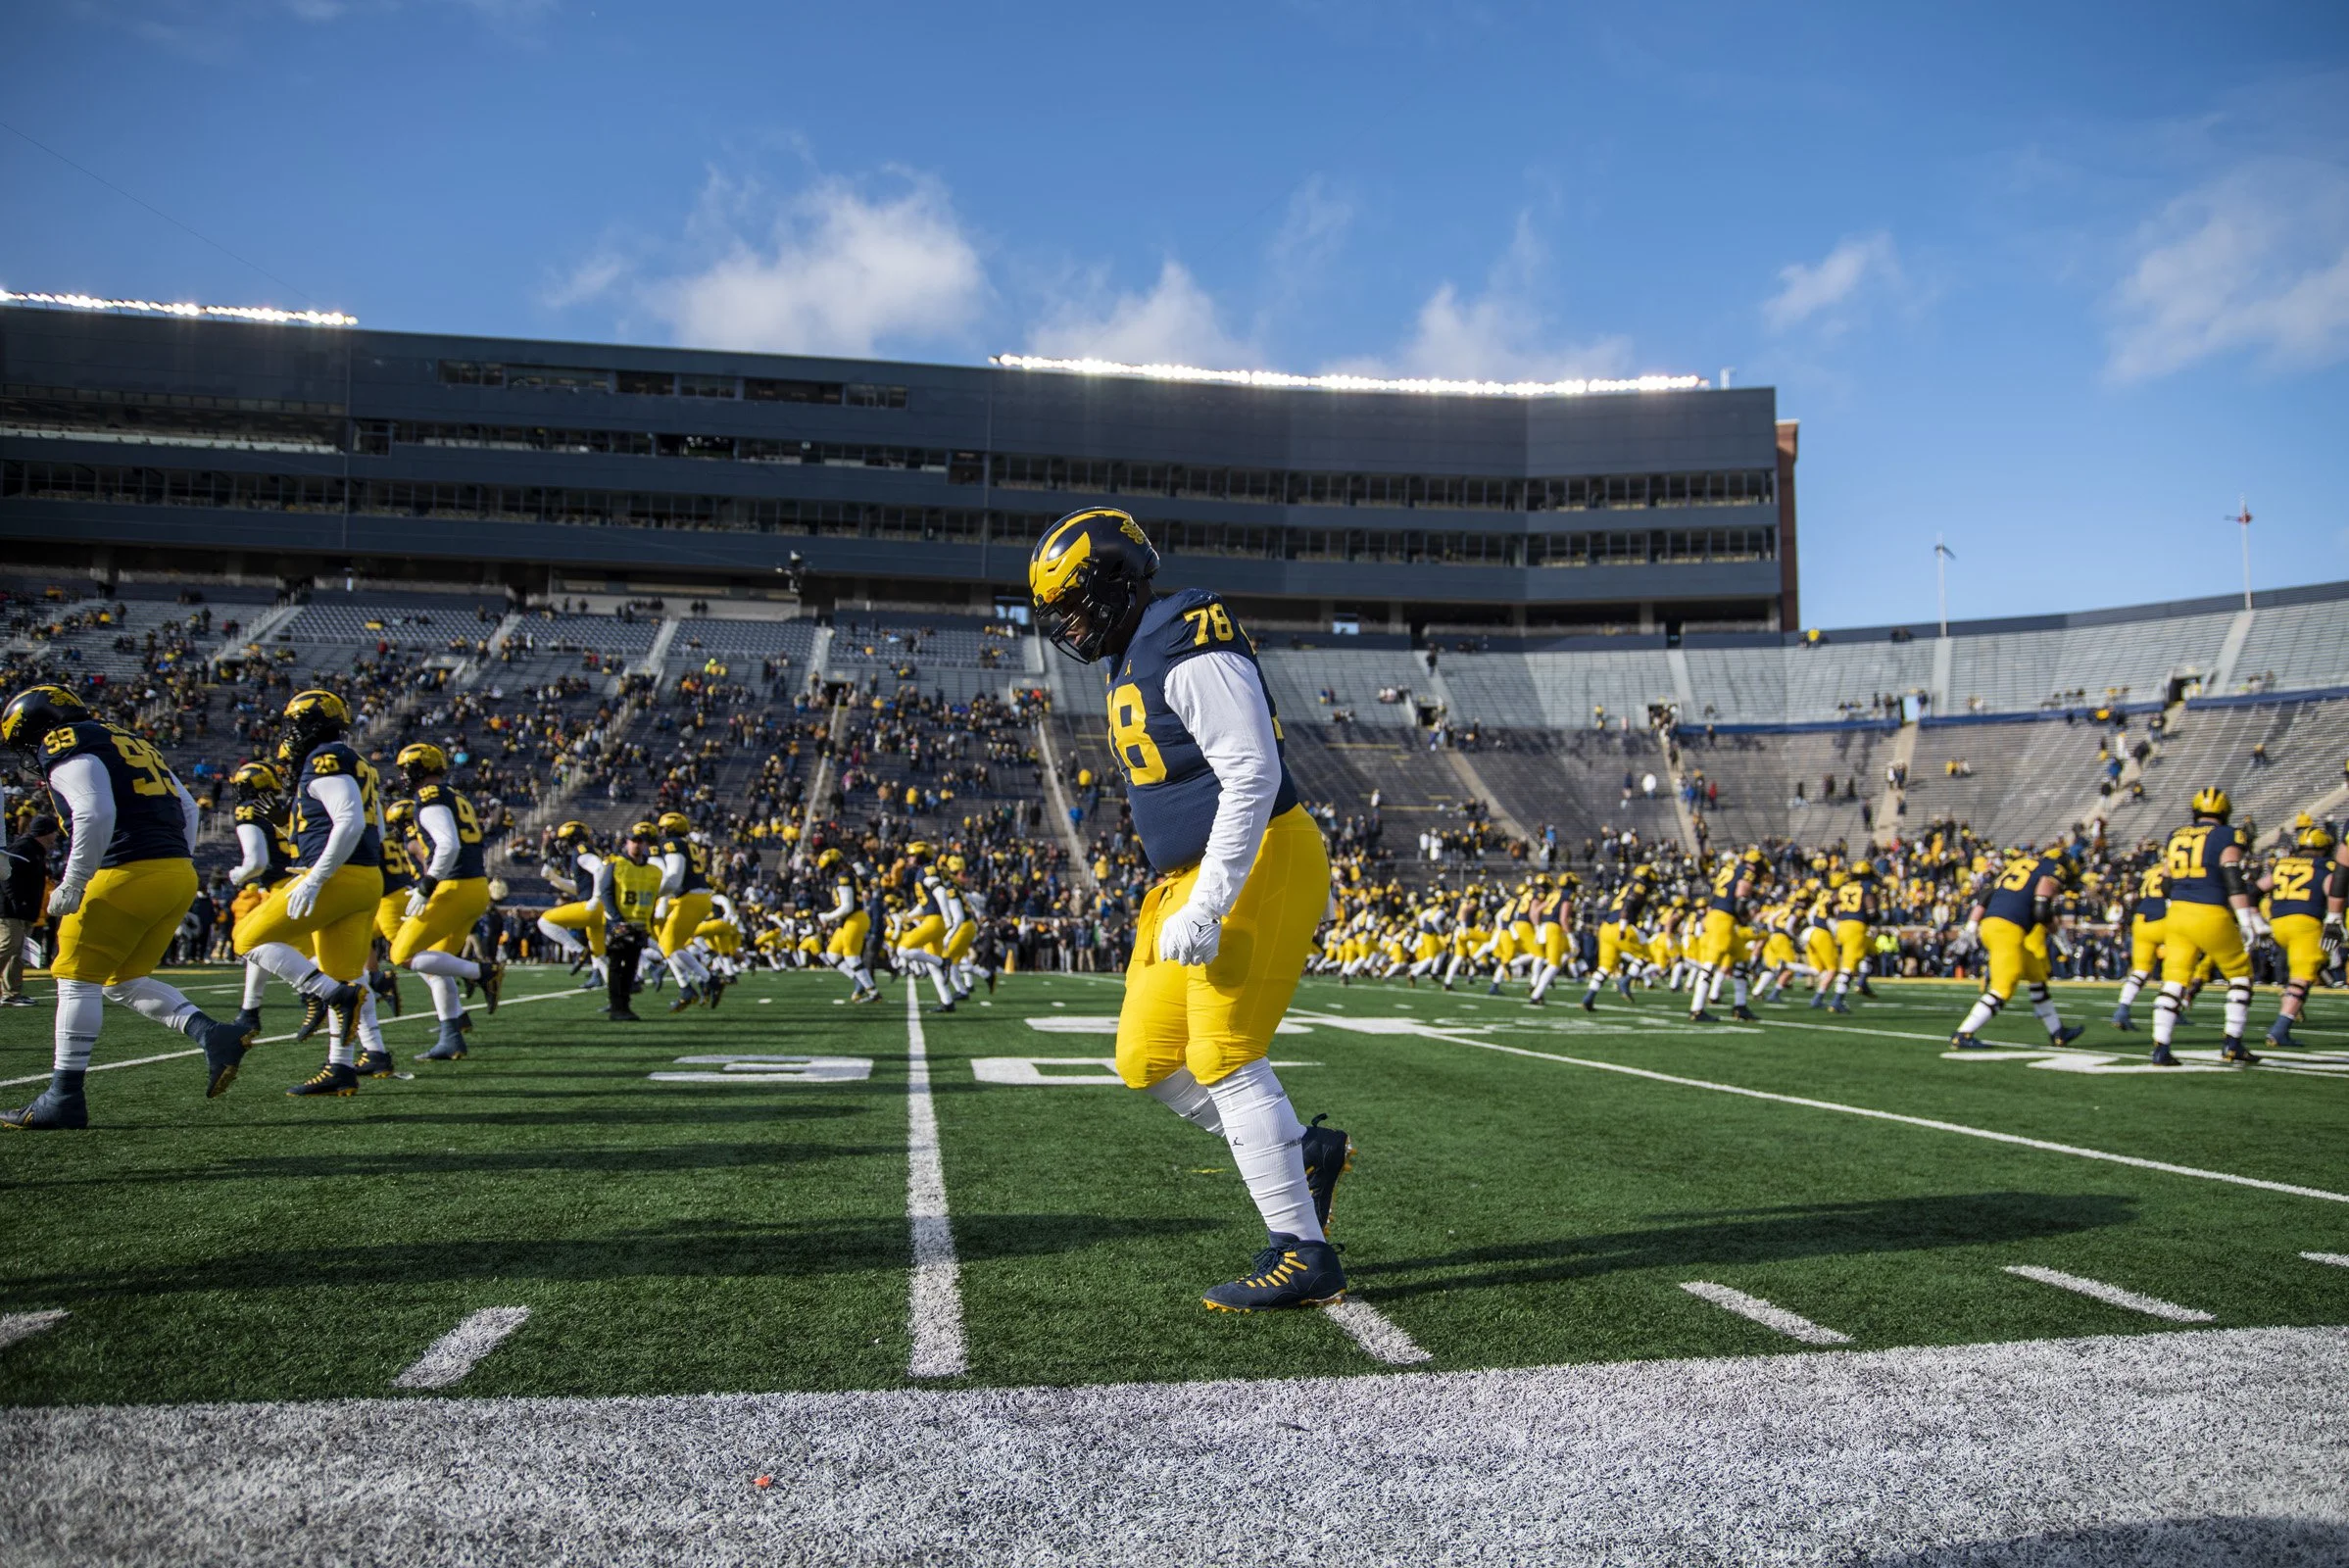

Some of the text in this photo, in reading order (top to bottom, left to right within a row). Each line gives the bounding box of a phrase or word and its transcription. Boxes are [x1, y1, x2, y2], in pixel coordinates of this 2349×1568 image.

[1184, 603, 1235, 646] 78
[43, 727, 77, 755] 99
[1106, 683, 1167, 786] 8
[234, 806, 255, 820] 54
[1994, 858, 2039, 892] 75
[2168, 836, 2208, 880] 61
[2273, 864, 2315, 902] 52
